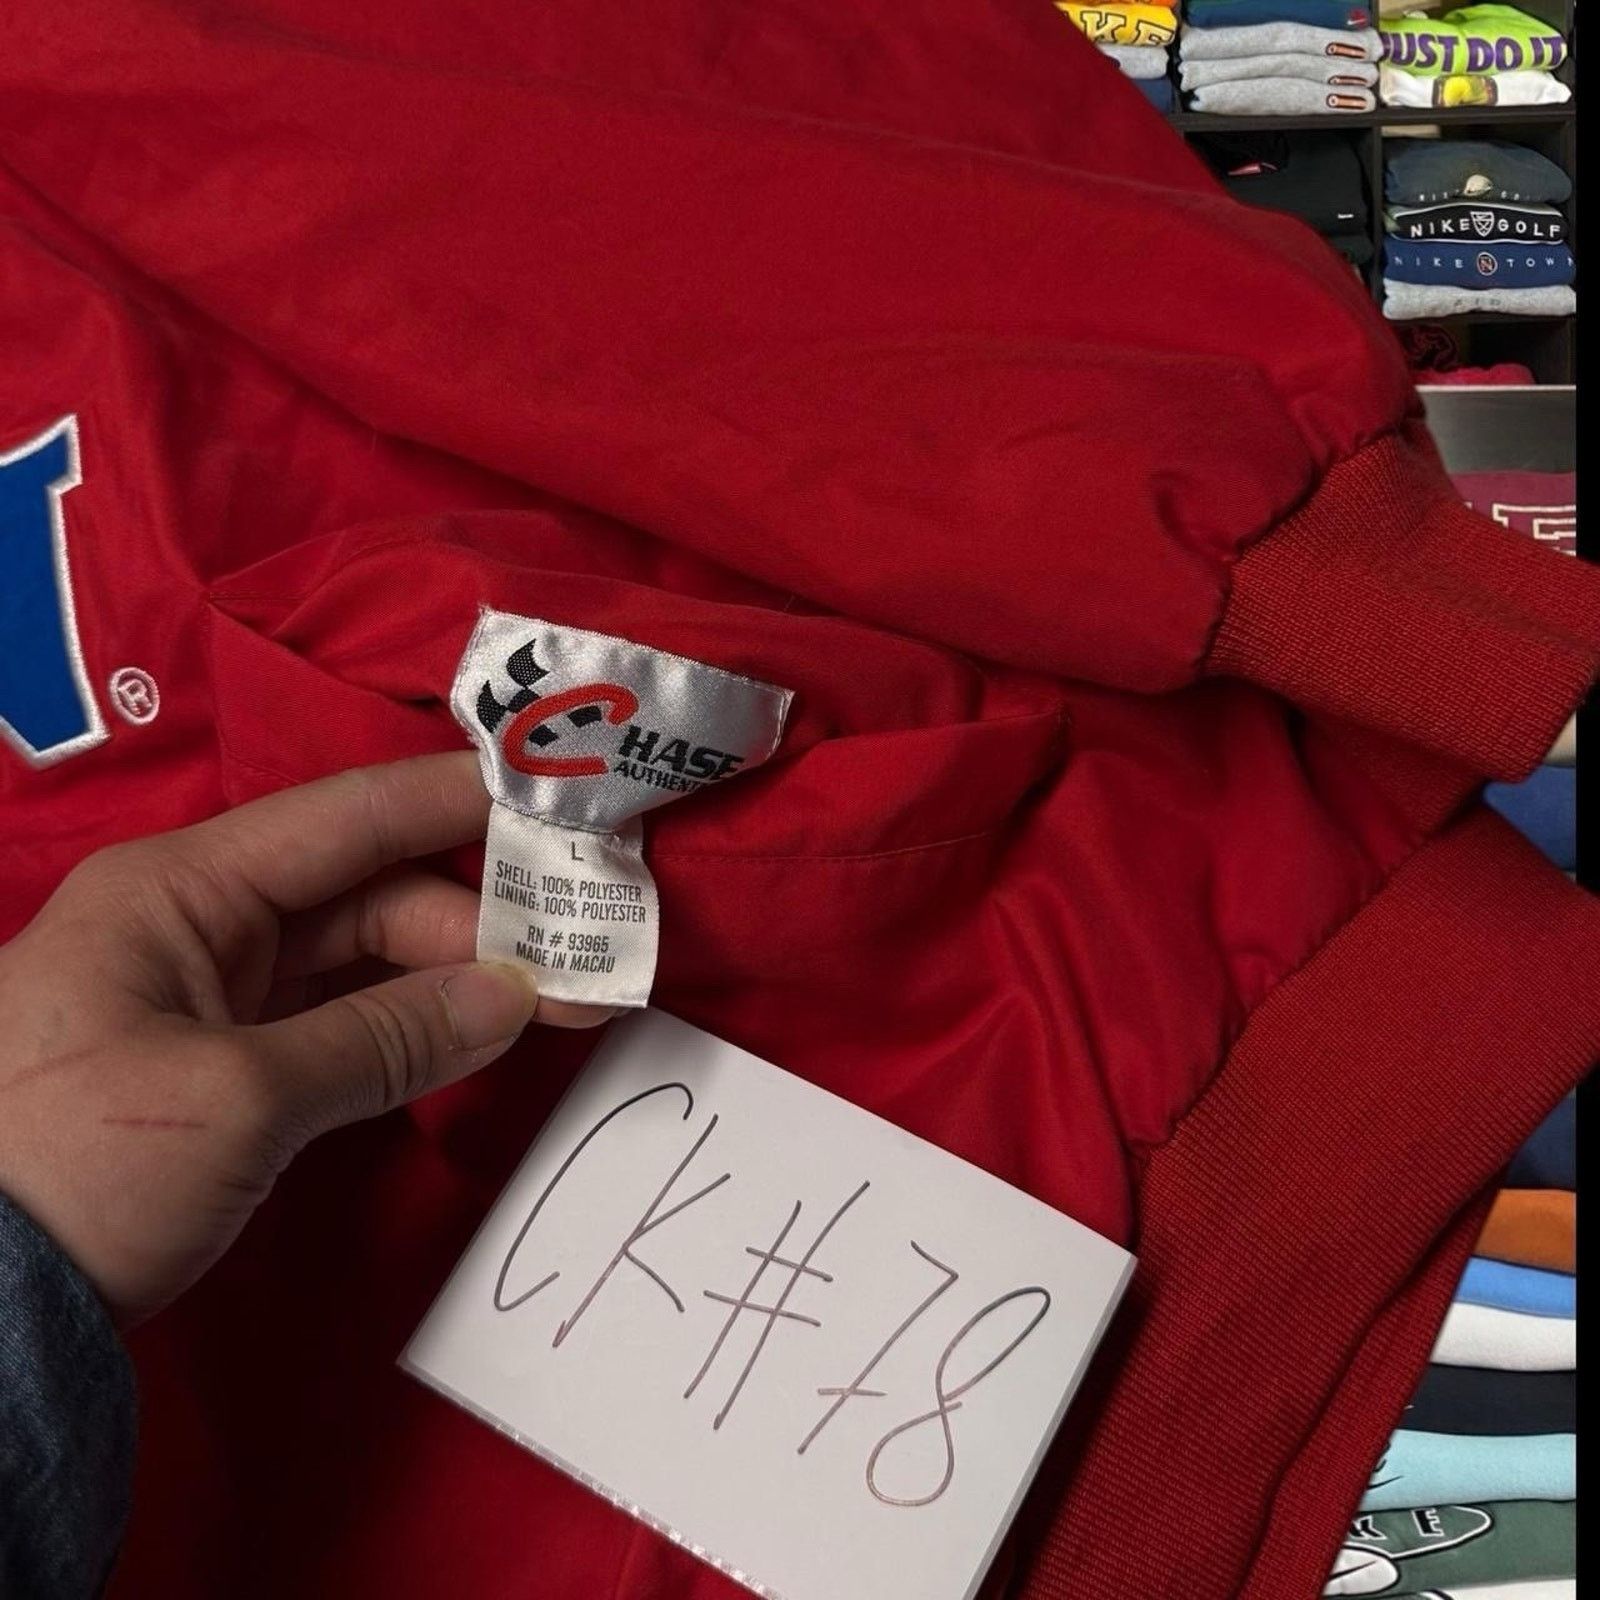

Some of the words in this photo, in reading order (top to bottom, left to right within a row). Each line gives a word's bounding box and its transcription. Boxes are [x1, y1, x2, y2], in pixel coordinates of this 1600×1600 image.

[1466, 36, 1524, 72] DO
[1529, 35, 1564, 68] IT
[1410, 217, 1471, 238] NIKE
[1497, 218, 1561, 238] GOLF
[1395, 256, 1464, 269] NIKE
[571, 841, 584, 861] L
[495, 860, 537, 890] SHELL:
[541, 875, 574, 897] 100%
[579, 880, 642, 903] POLYESTER
[494, 880, 540, 912] LINING:
[544, 896, 577, 918] 100%
[581, 901, 646, 924] POLYESTER
[527, 925, 545, 945] RN
[549, 931, 564, 948] #
[567, 933, 609, 953] 93965
[516, 941, 549, 968] MADE
[551, 951, 567, 970] IN
[569, 954, 616, 974] MACAU
